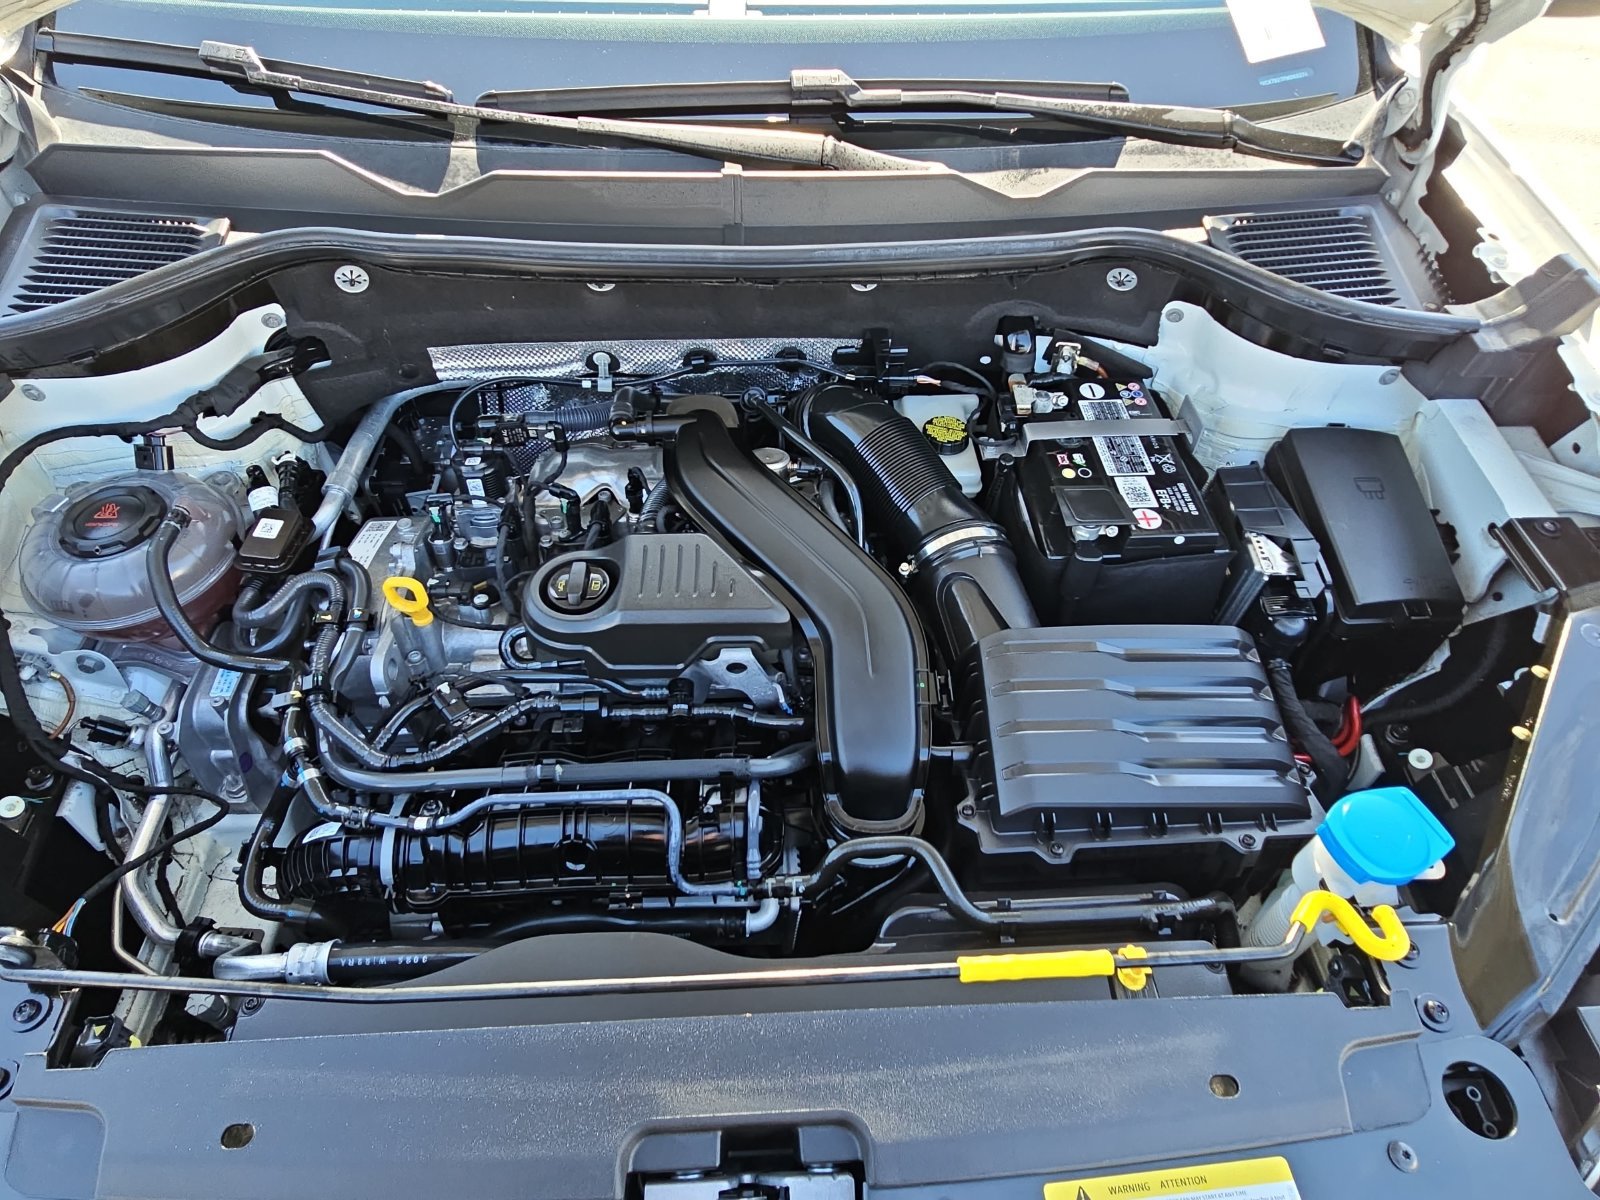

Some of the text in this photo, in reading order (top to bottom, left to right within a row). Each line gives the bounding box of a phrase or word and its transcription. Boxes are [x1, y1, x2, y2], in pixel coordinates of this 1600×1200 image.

[1156, 489, 1172, 510] EFB+
[1108, 1176, 1207, 1195] WARNING ATTENTION
